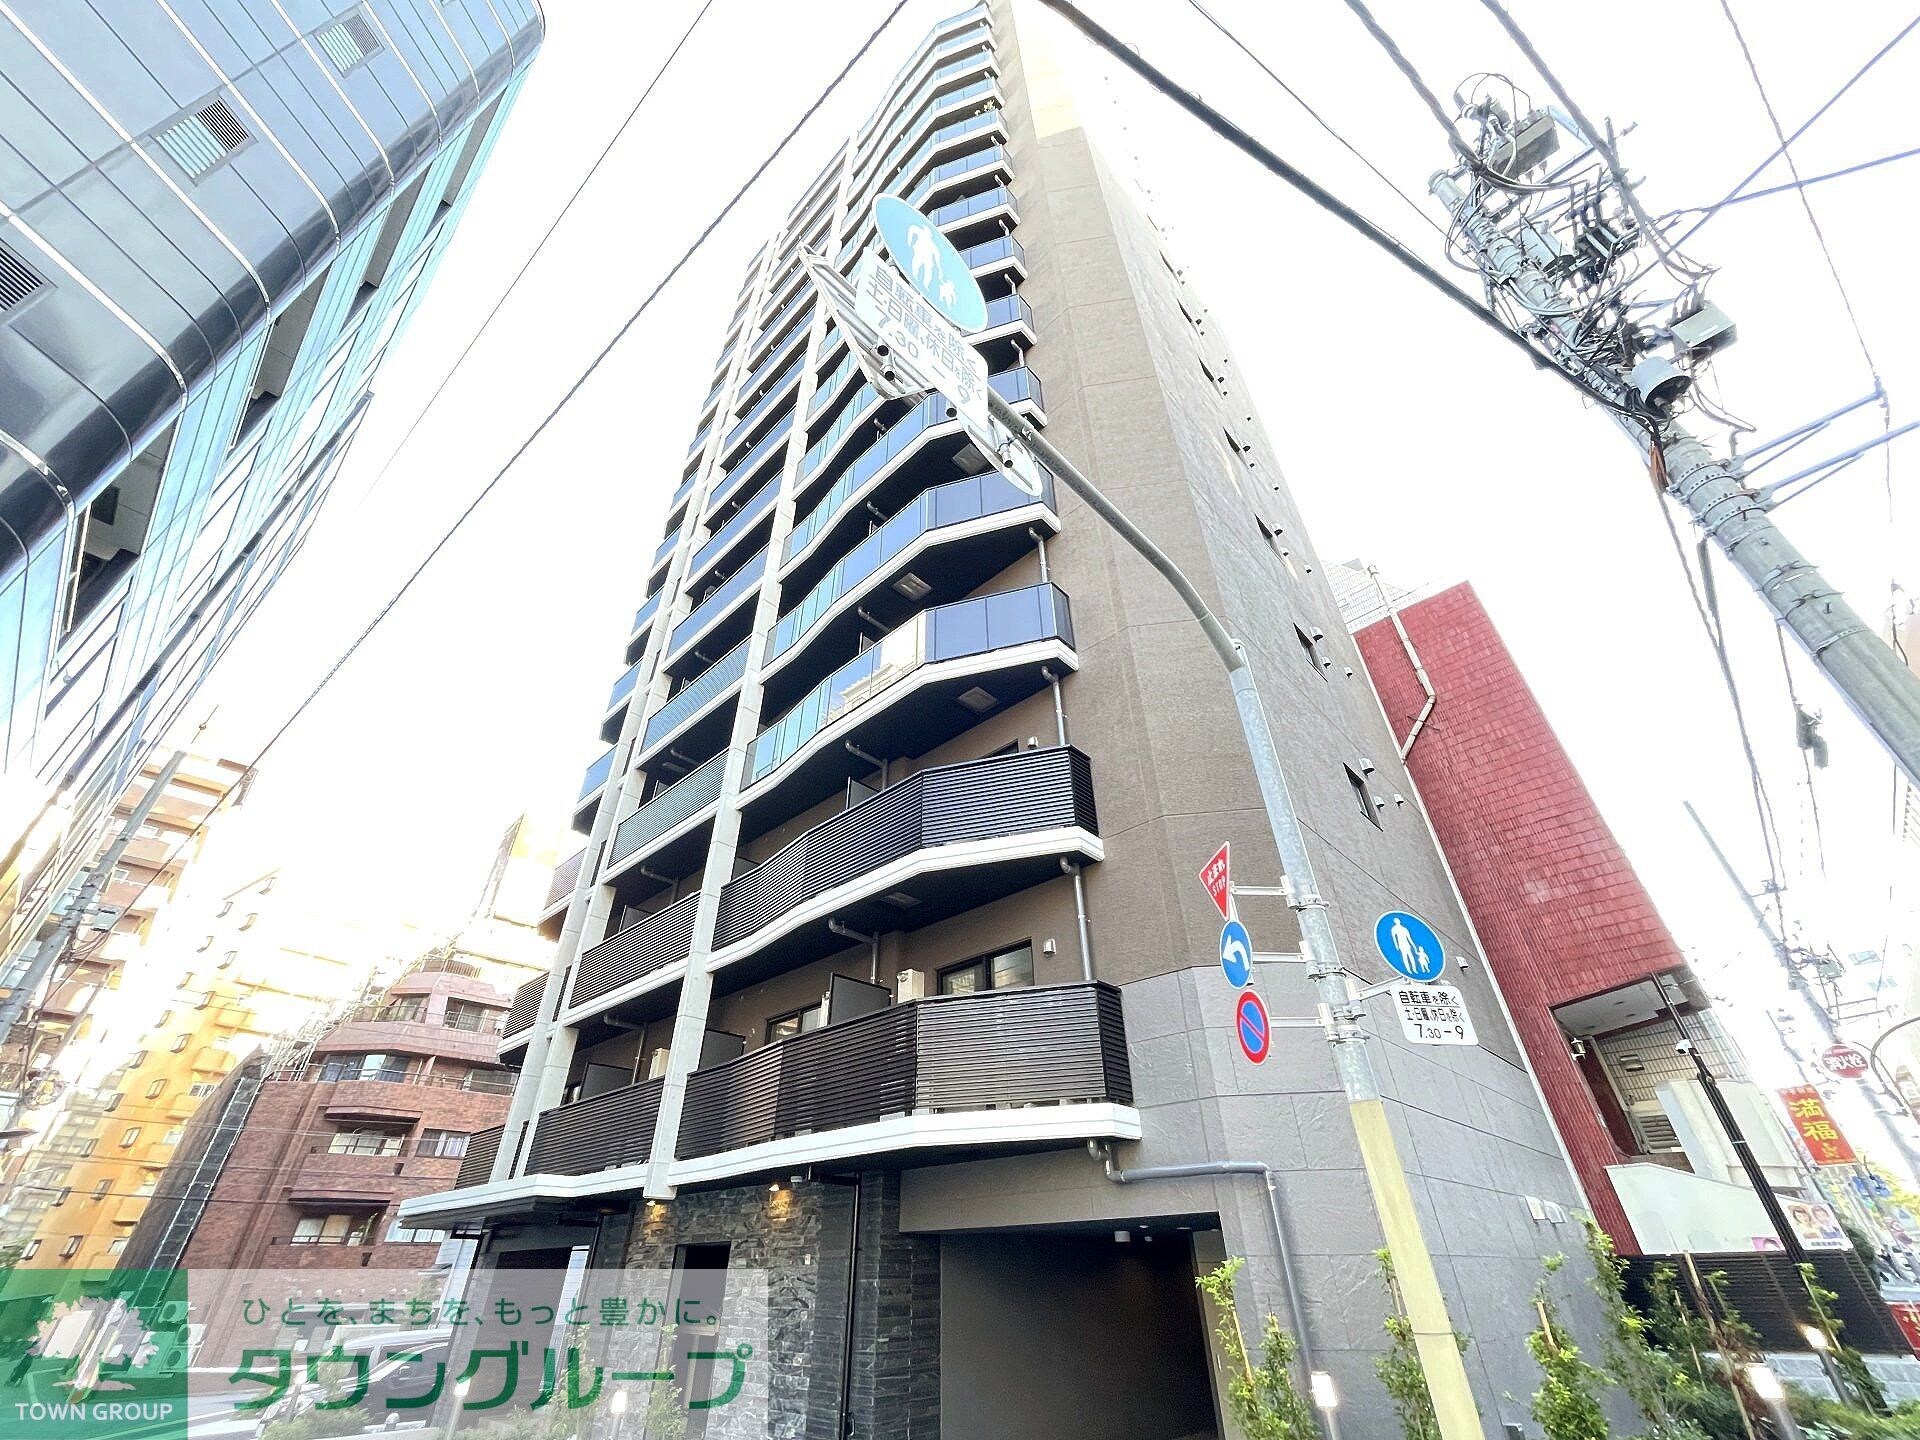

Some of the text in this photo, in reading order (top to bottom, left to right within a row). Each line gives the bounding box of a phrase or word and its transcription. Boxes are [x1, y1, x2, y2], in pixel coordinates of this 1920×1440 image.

[1207, 858, 1226, 887] 止まれ
[1212, 875, 1226, 897] STOP
[1398, 990, 1460, 1006] 自転車を除く
